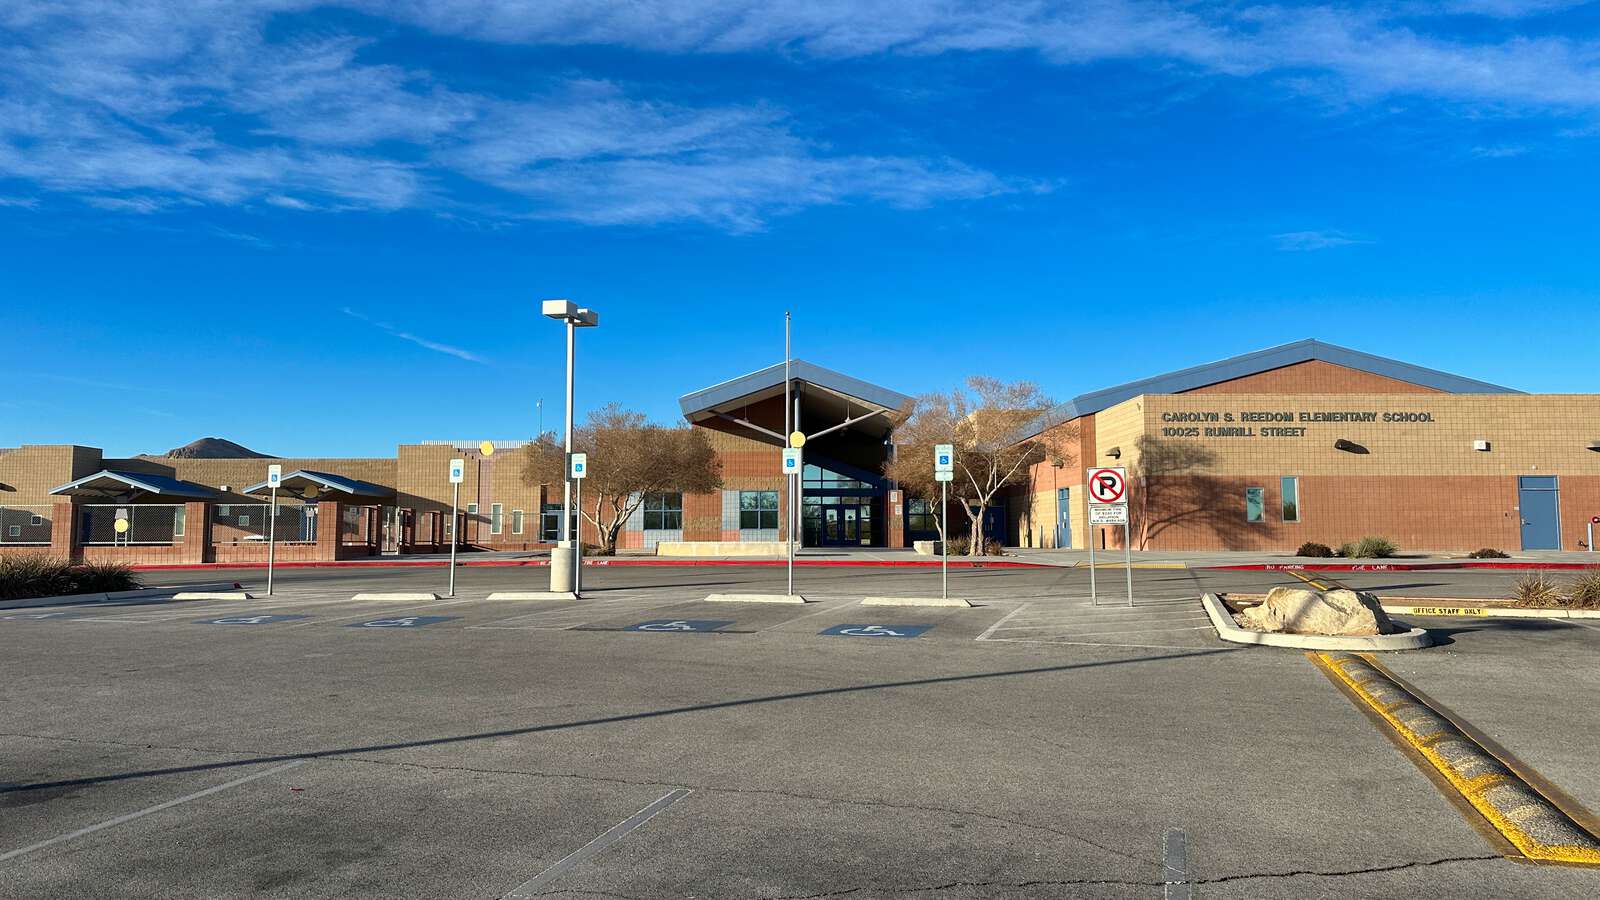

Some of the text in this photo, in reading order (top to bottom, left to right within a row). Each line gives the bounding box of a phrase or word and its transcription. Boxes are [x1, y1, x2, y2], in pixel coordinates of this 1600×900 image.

[1162, 412, 1435, 422] CAROLYN S. REEDOM ELEMENTARY SCHOOL
[1162, 427, 1306, 437] 10025 RUMRILL STREET
